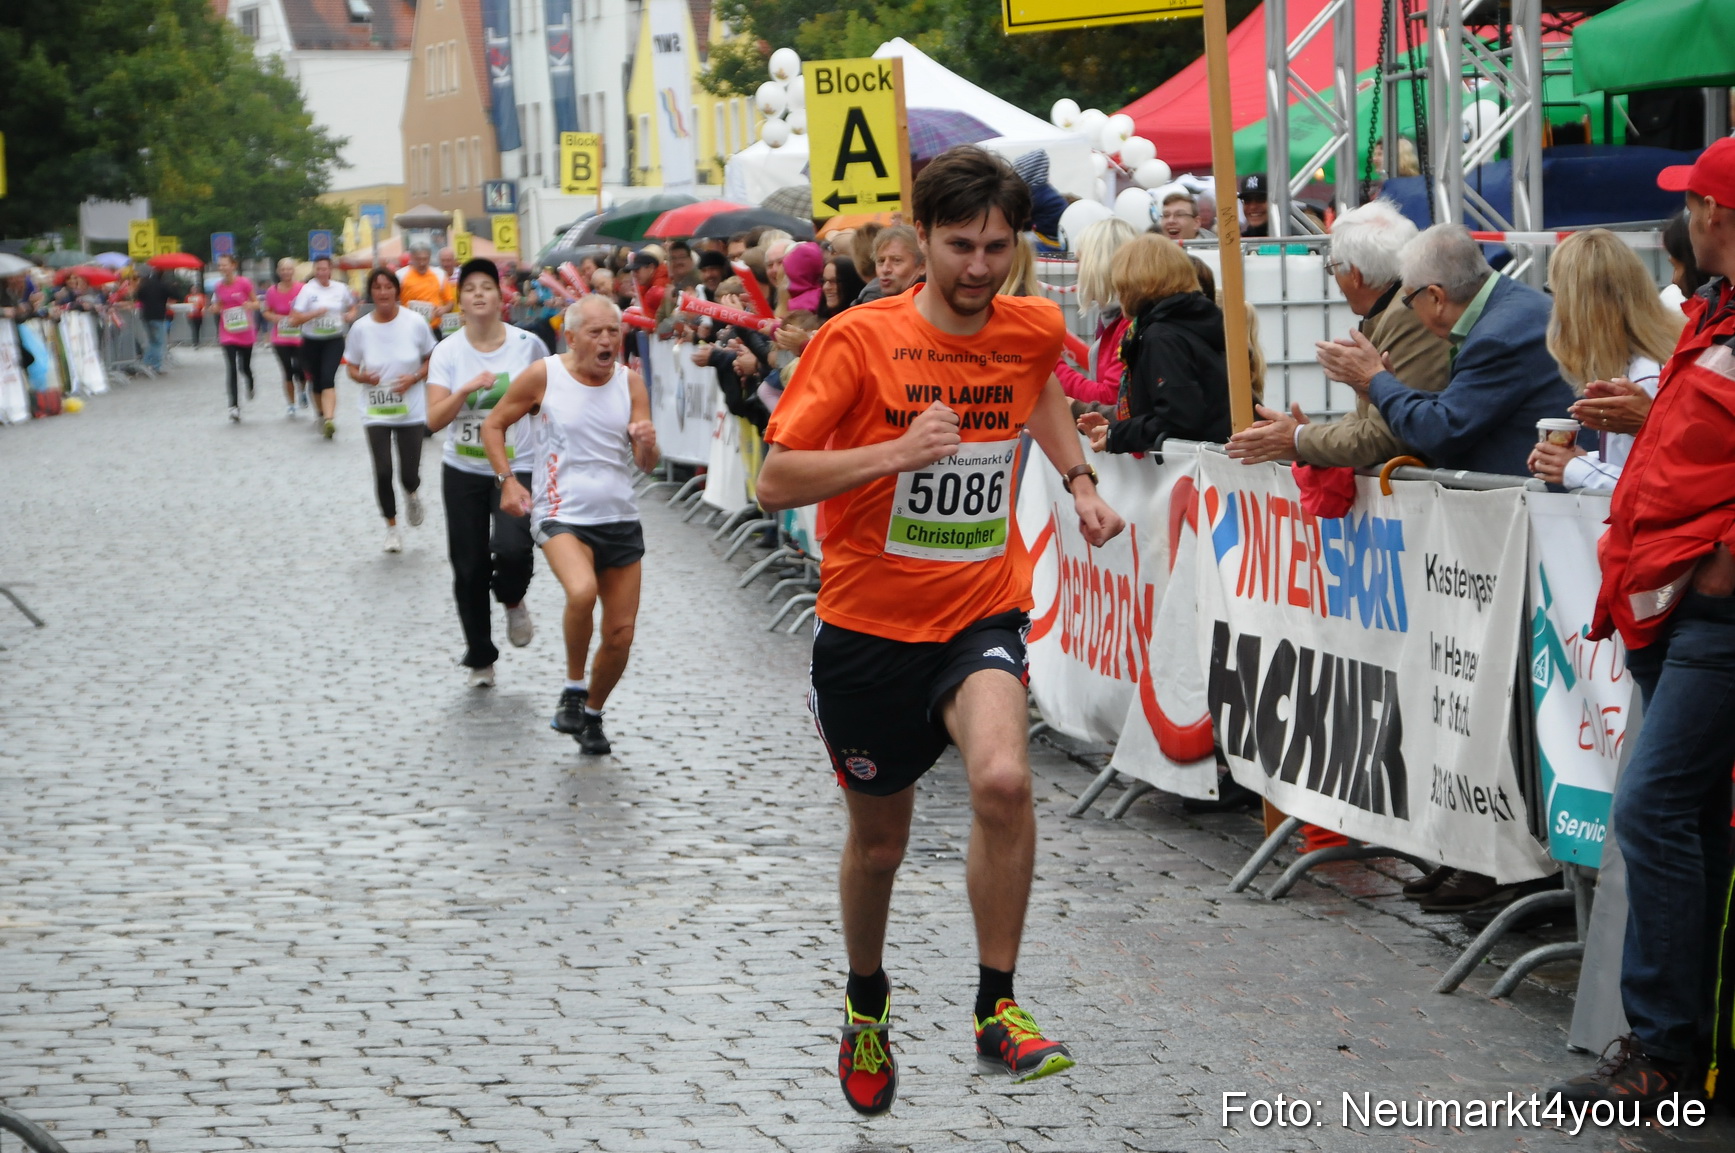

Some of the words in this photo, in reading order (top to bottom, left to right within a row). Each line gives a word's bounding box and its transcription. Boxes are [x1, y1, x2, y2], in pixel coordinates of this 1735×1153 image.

[815, 64, 893, 95] Block
[565, 135, 598, 147] Block
[832, 106, 889, 181] A
[572, 151, 591, 181] B
[135, 230, 148, 248] C
[499, 226, 512, 243] C
[685, 300, 717, 316] Audi
[892, 348, 923, 361] JFW
[928, 350, 1022, 366] Running-Team
[905, 384, 942, 403] WIR
[949, 385, 1013, 404] LAUFEN
[948, 454, 1002, 466] Neumarkt
[908, 471, 1005, 516] 5086
[906, 524, 995, 549] Christopher
[1236, 489, 1408, 633] INTERSPORT
[1208, 619, 1410, 822] HICKNER
[1555, 810, 1608, 843] Servic
